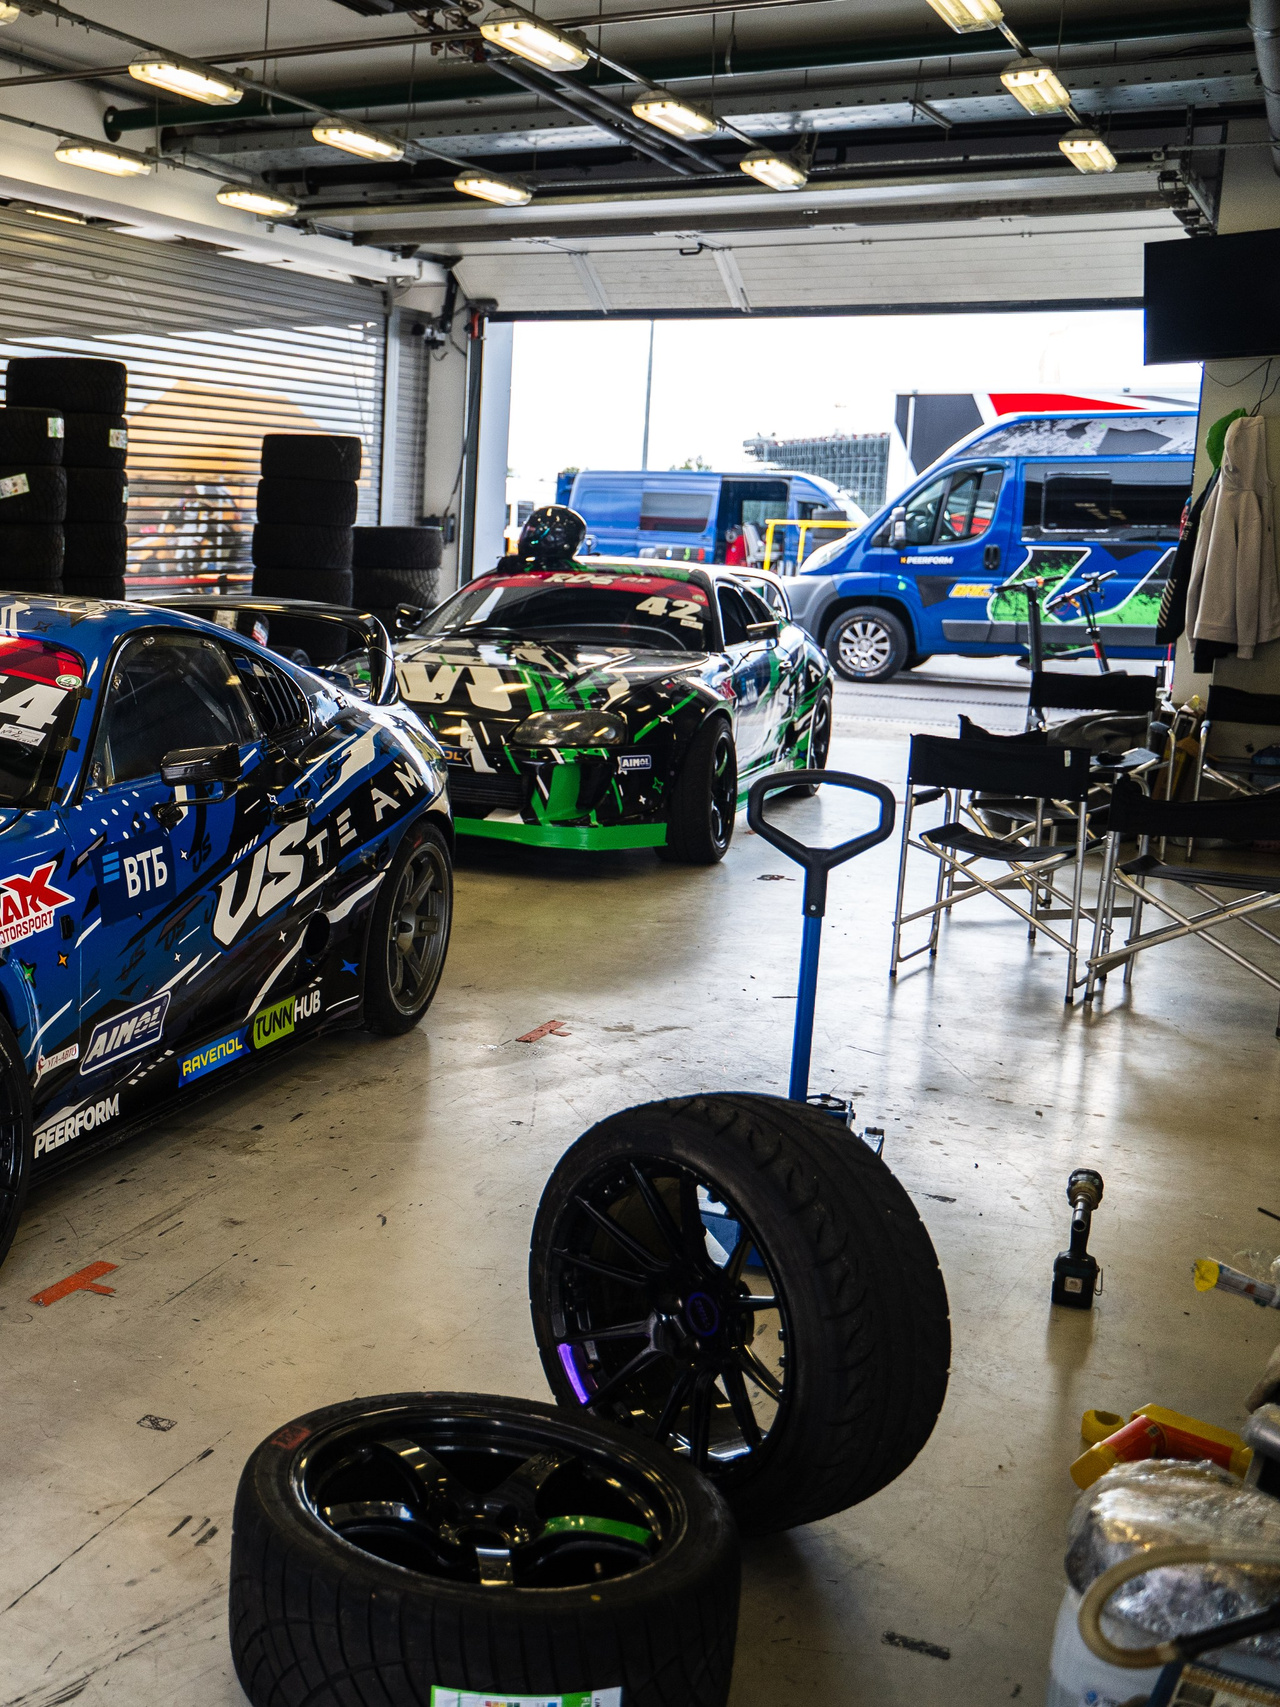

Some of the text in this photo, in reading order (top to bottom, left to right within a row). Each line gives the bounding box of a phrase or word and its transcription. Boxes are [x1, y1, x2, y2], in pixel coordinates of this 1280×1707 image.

[543, 573, 619, 585] RDS
[635, 596, 703, 621] 42
[621, 756, 651, 769] AIMOL
[123, 846, 168, 899] ВТБ
[213, 761, 424, 946] US TEAM
[84, 1005, 162, 1065] AIMOL
[181, 1035, 243, 1078] RAVENOL
[34, 1093, 120, 1159] PEERFORM
